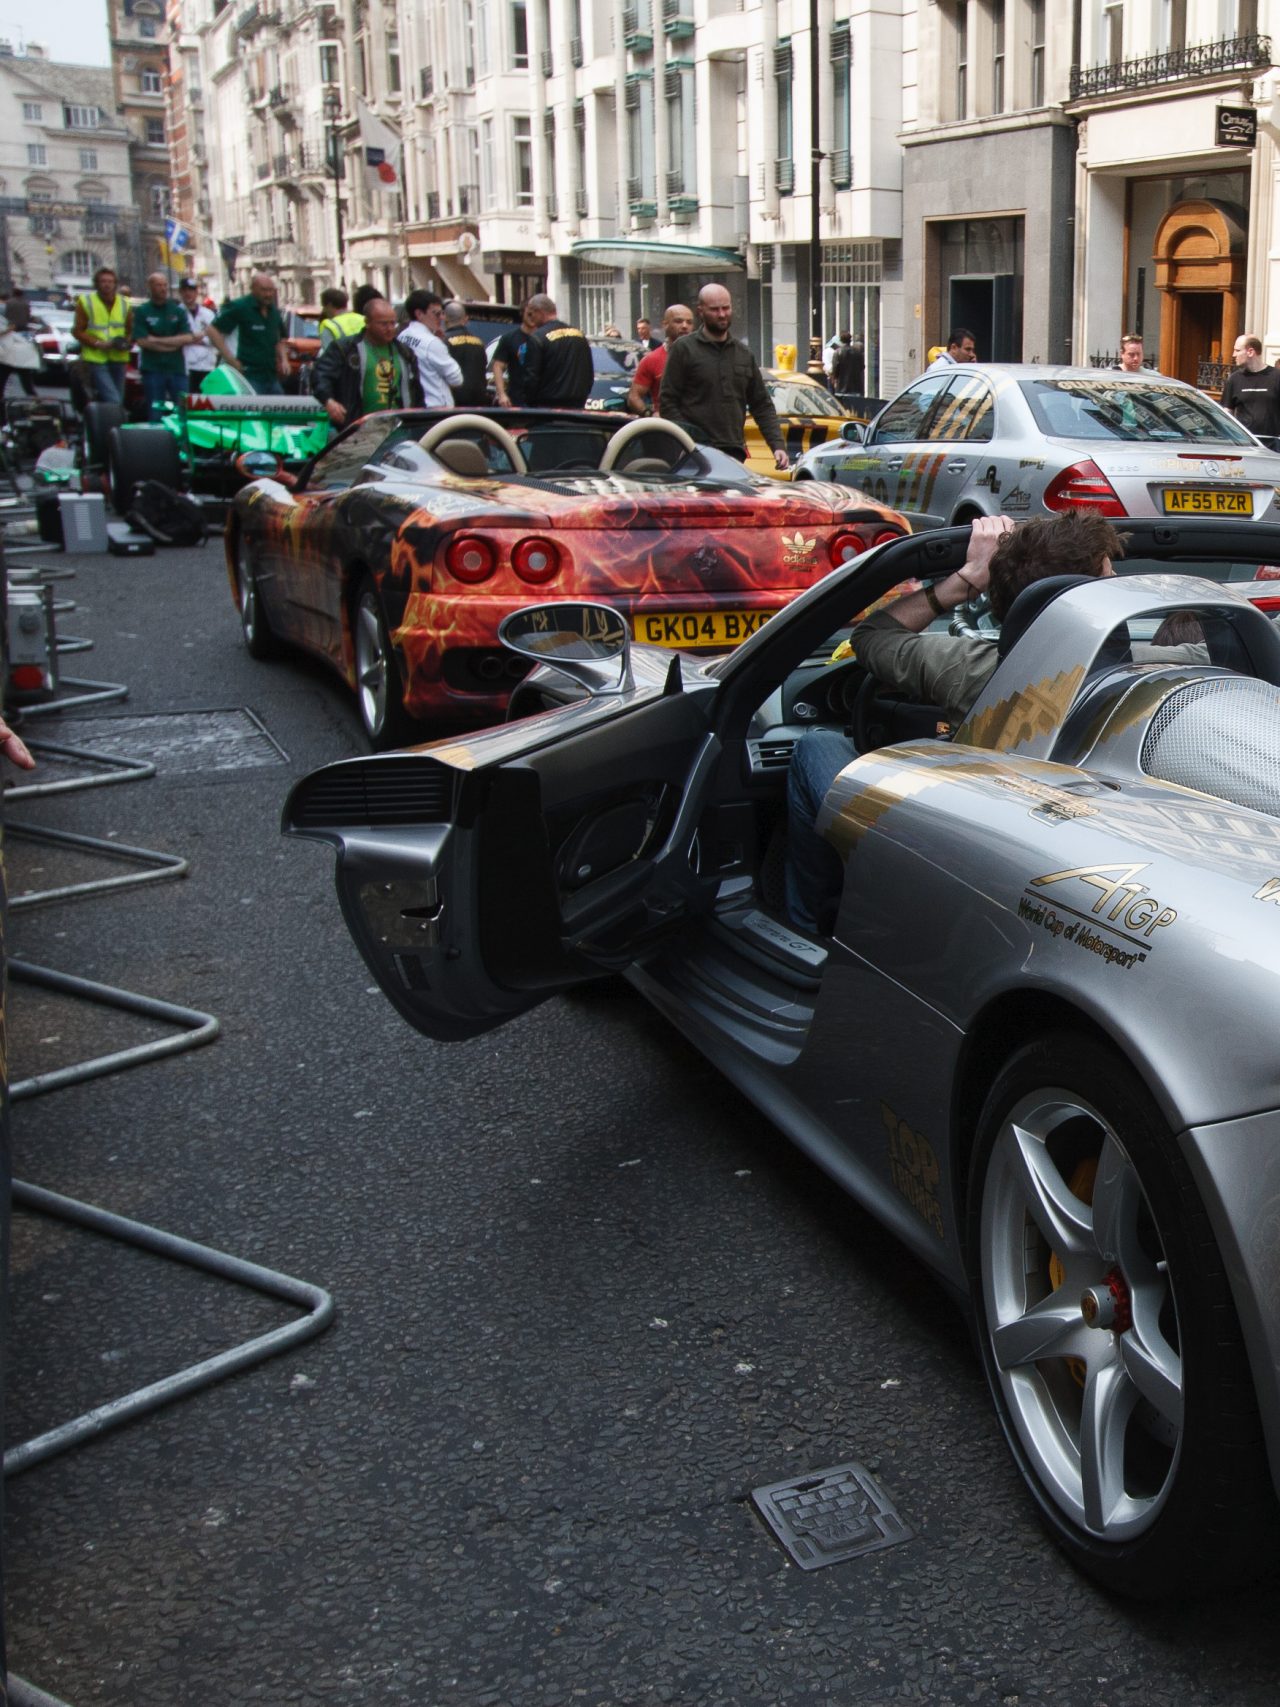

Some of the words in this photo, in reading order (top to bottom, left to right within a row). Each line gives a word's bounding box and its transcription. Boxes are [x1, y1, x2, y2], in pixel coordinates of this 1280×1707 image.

[1170, 493, 1213, 510] AF55
[1216, 495, 1247, 512] RZR
[645, 616, 716, 642] GK04
[1018, 897, 1046, 926] World
[1043, 910, 1065, 938] Cup
[1063, 922, 1081, 941] of
